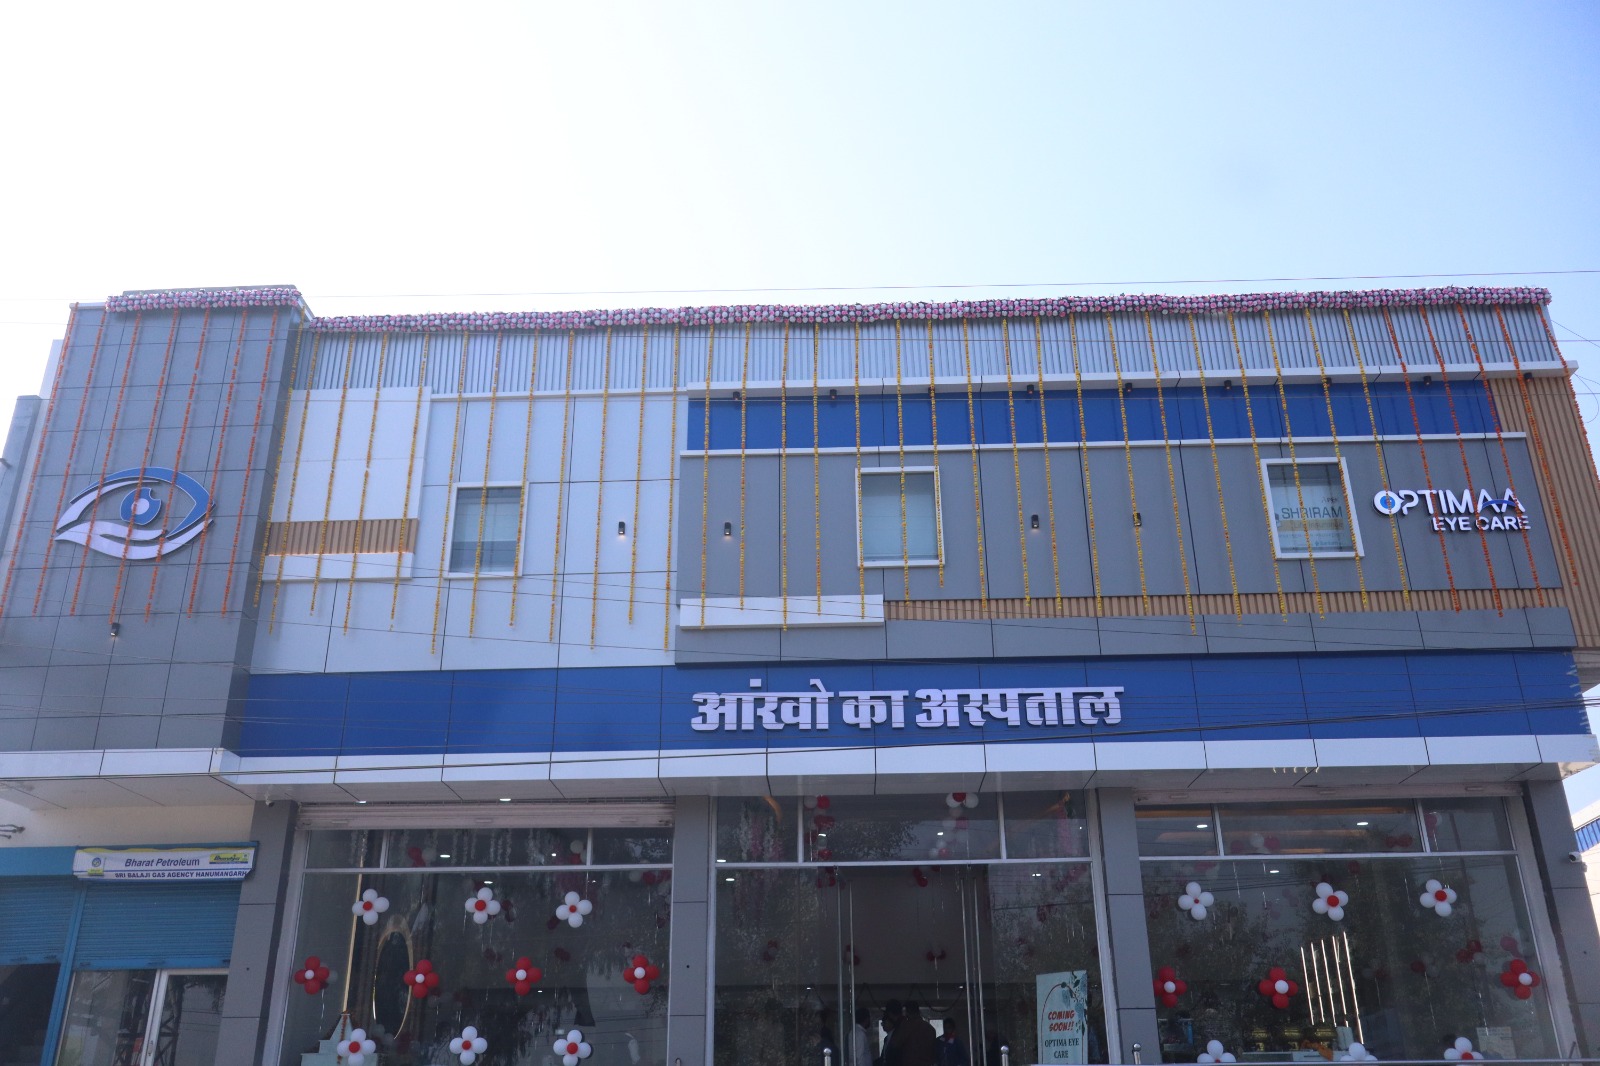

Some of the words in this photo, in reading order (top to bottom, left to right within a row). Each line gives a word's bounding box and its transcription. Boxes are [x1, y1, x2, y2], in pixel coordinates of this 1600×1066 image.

[1281, 505, 1343, 520] SHRIRAM
[1432, 516, 1473, 532] EYE
[1475, 515, 1532, 532] CARE
[690, 678, 835, 731] आंखो
[838, 689, 910, 729] का
[914, 685, 1125, 728] अस्पताल
[124, 858, 154, 867] Bharat
[156, 857, 200, 867] Petroleum
[195, 870, 248, 878] HANUMANGARH
[1048, 1010, 1075, 1020] COMING
[1049, 1022, 1074, 1032] SOON!!
[1045, 1039, 1067, 1047] OPTIMA
[1068, 1038, 1079, 1046] EYE
